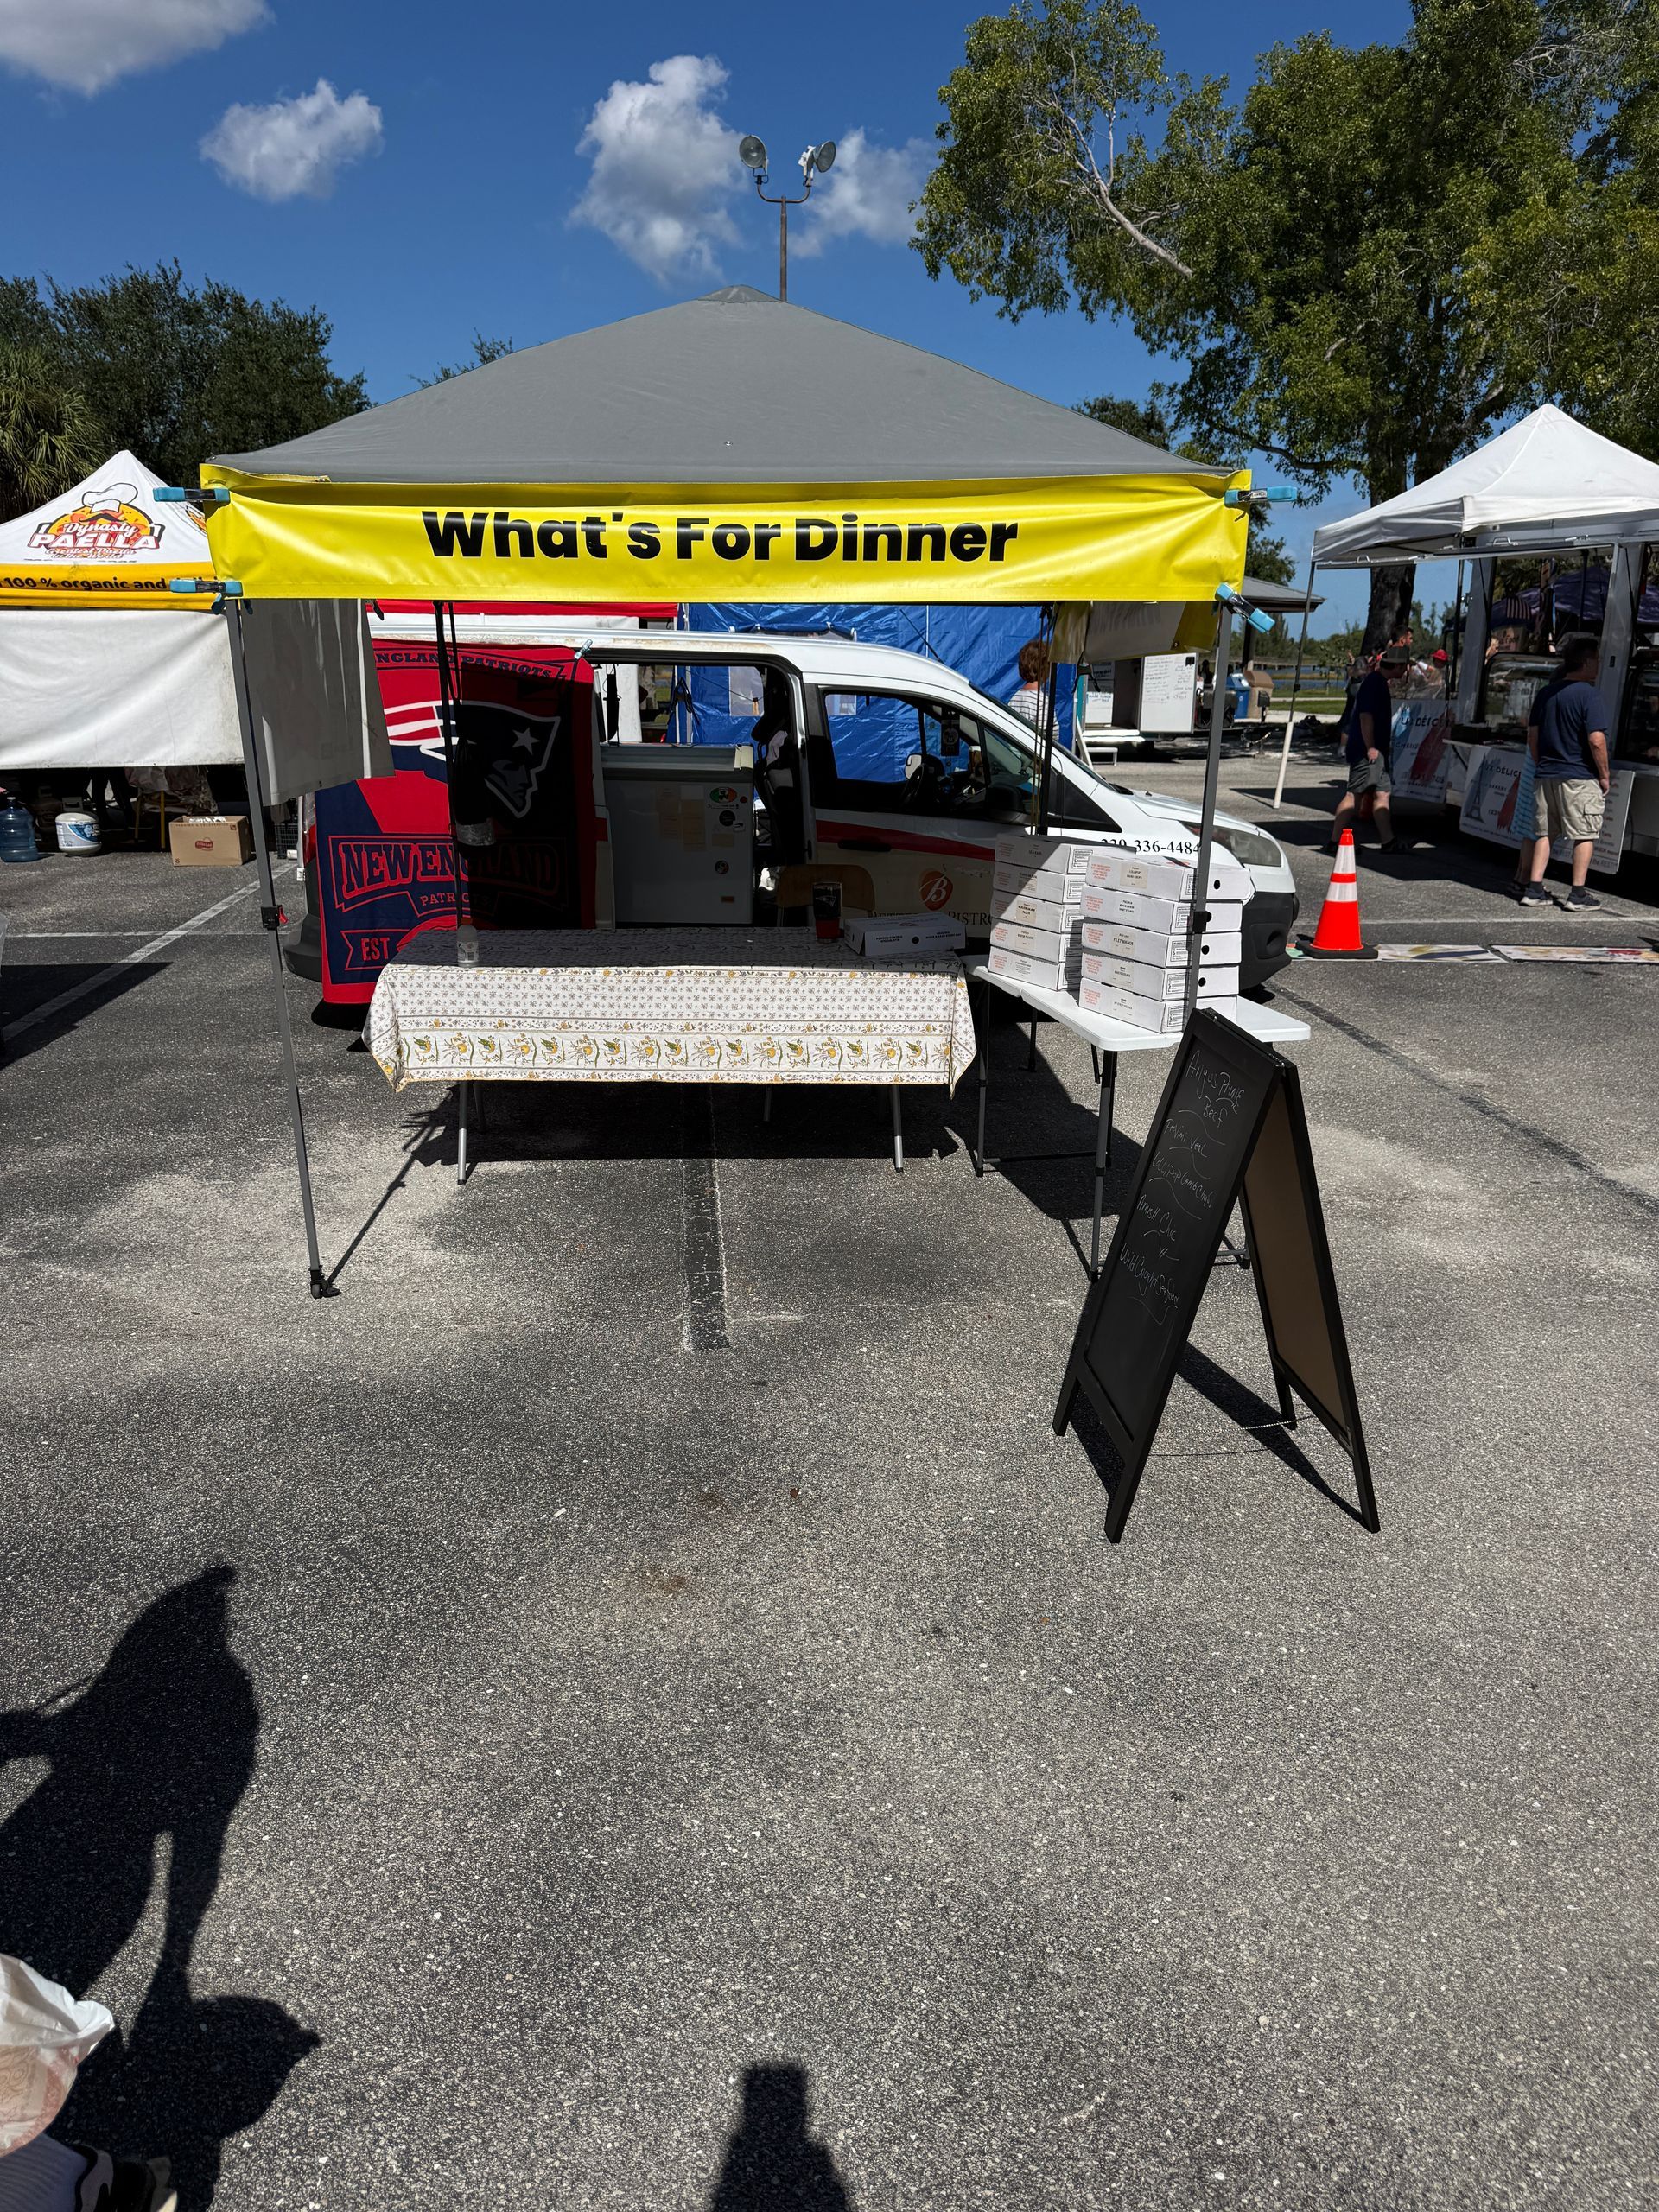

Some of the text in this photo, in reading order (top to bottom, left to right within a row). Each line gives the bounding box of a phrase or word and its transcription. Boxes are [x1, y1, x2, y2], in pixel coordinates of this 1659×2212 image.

[64, 522, 140, 537] Dynasty
[421, 510, 1019, 562] What's For Dinner
[30, 532, 161, 550] PAELLA
[3, 576, 168, 591] 100 % organic and
[340, 843, 415, 897] NEW
[360, 937, 391, 962] EST
